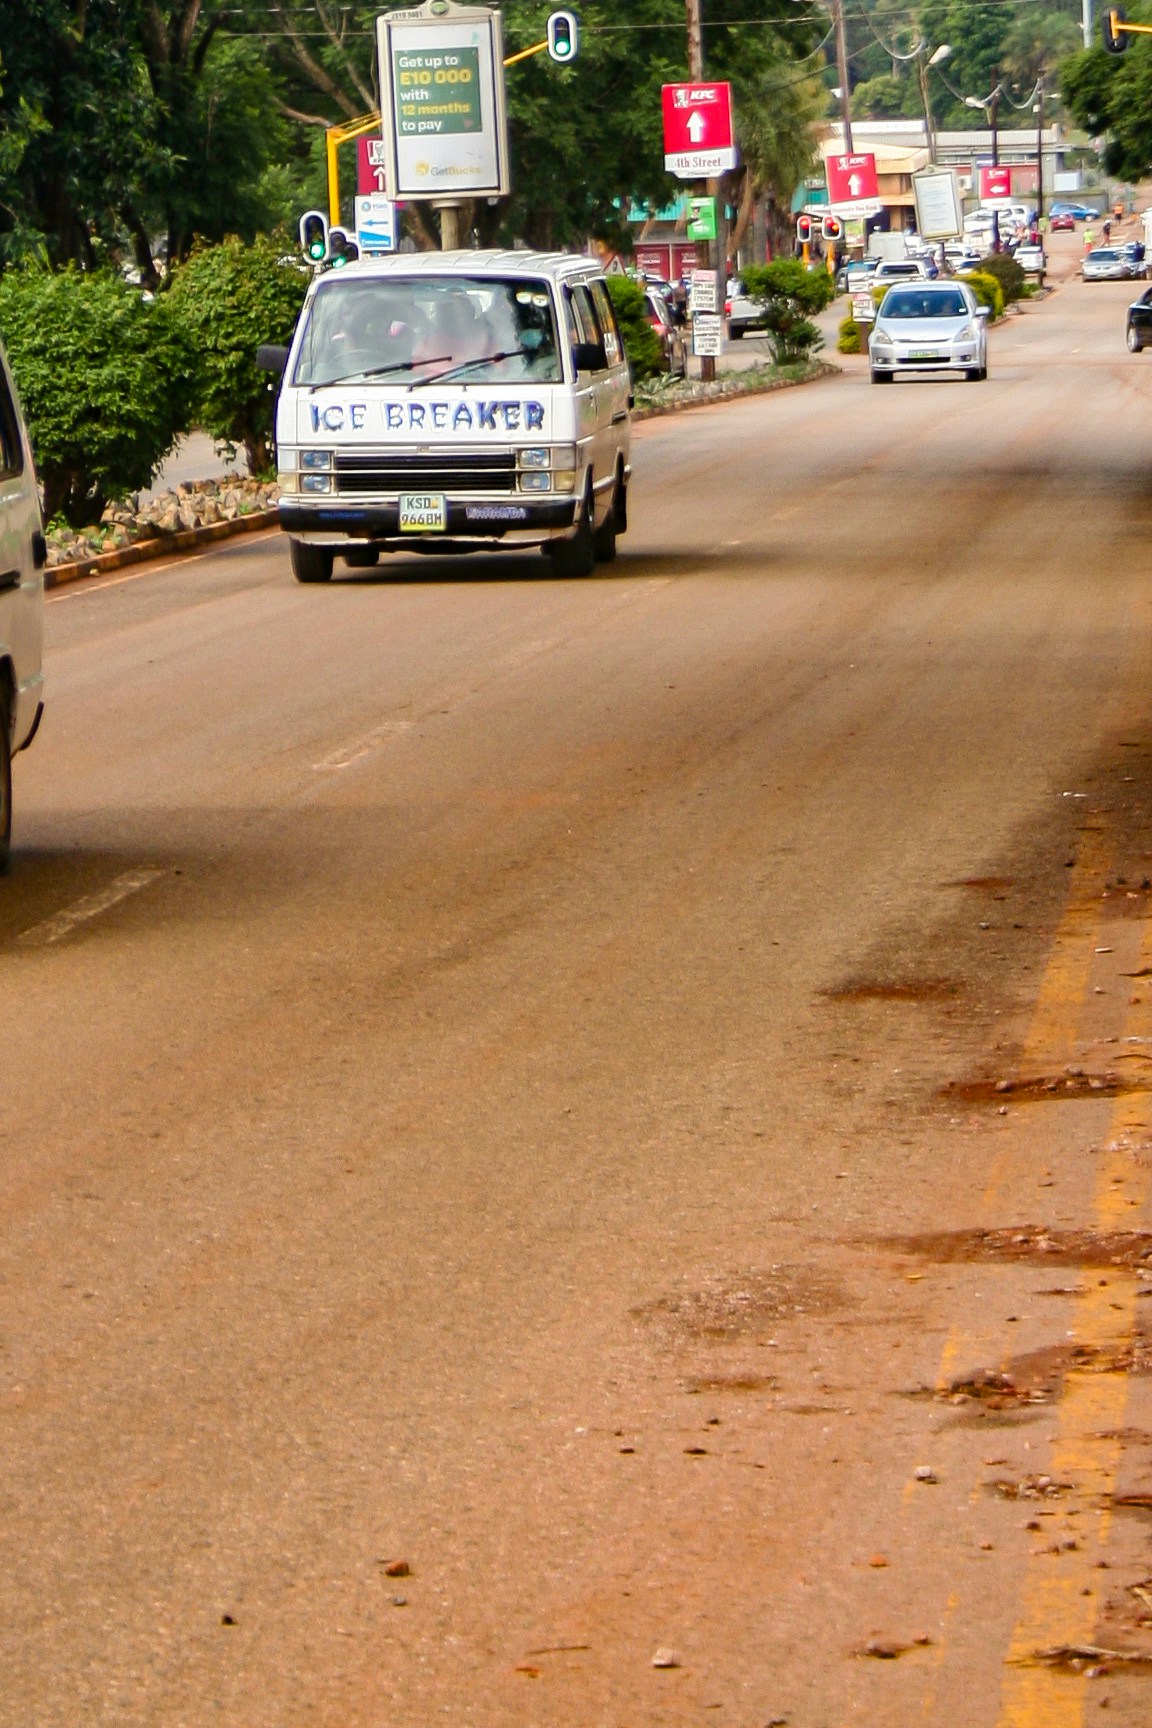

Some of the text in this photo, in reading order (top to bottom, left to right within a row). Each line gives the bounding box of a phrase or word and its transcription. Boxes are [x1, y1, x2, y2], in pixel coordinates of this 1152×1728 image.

[399, 56, 458, 69] Get up to
[400, 69, 473, 85] E10 000
[400, 90, 429, 101] with
[690, 90, 716, 100] KFC
[402, 102, 471, 115] 12 months
[402, 120, 442, 133] to pay
[693, 157, 721, 167] Street
[431, 166, 481, 177] GetBucks
[310, 400, 545, 432] ICE BREAKER
[406, 496, 431, 509] KSD
